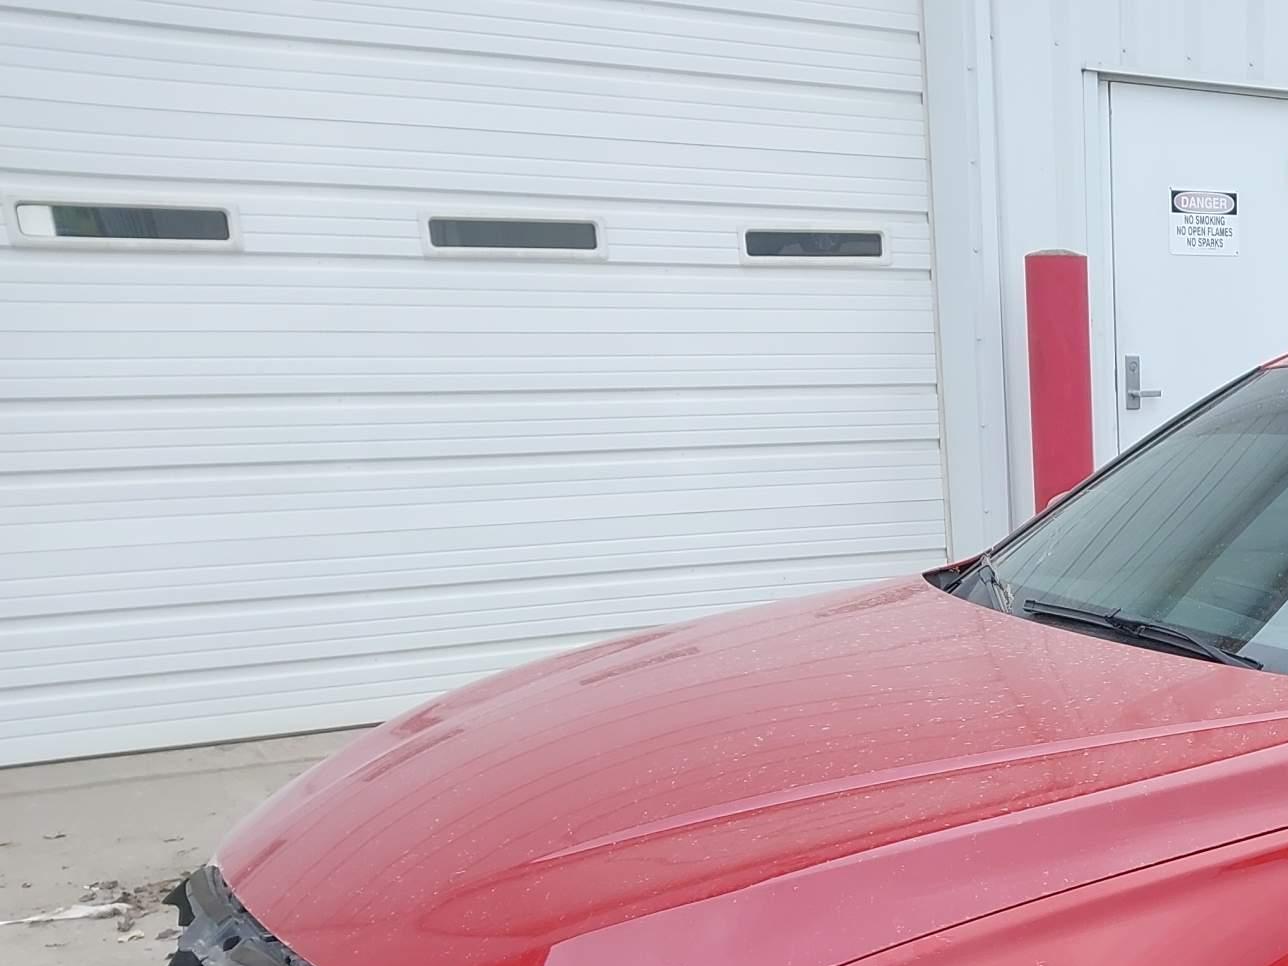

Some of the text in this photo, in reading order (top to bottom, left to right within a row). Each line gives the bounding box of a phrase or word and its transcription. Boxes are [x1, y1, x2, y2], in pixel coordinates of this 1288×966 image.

[1180, 196, 1227, 209] DANGER
[1184, 215, 1226, 226] NO SMOKING
[1176, 226, 1233, 237] NO OPEN FLAMES
[1187, 237, 1224, 248] NO SPARKS
